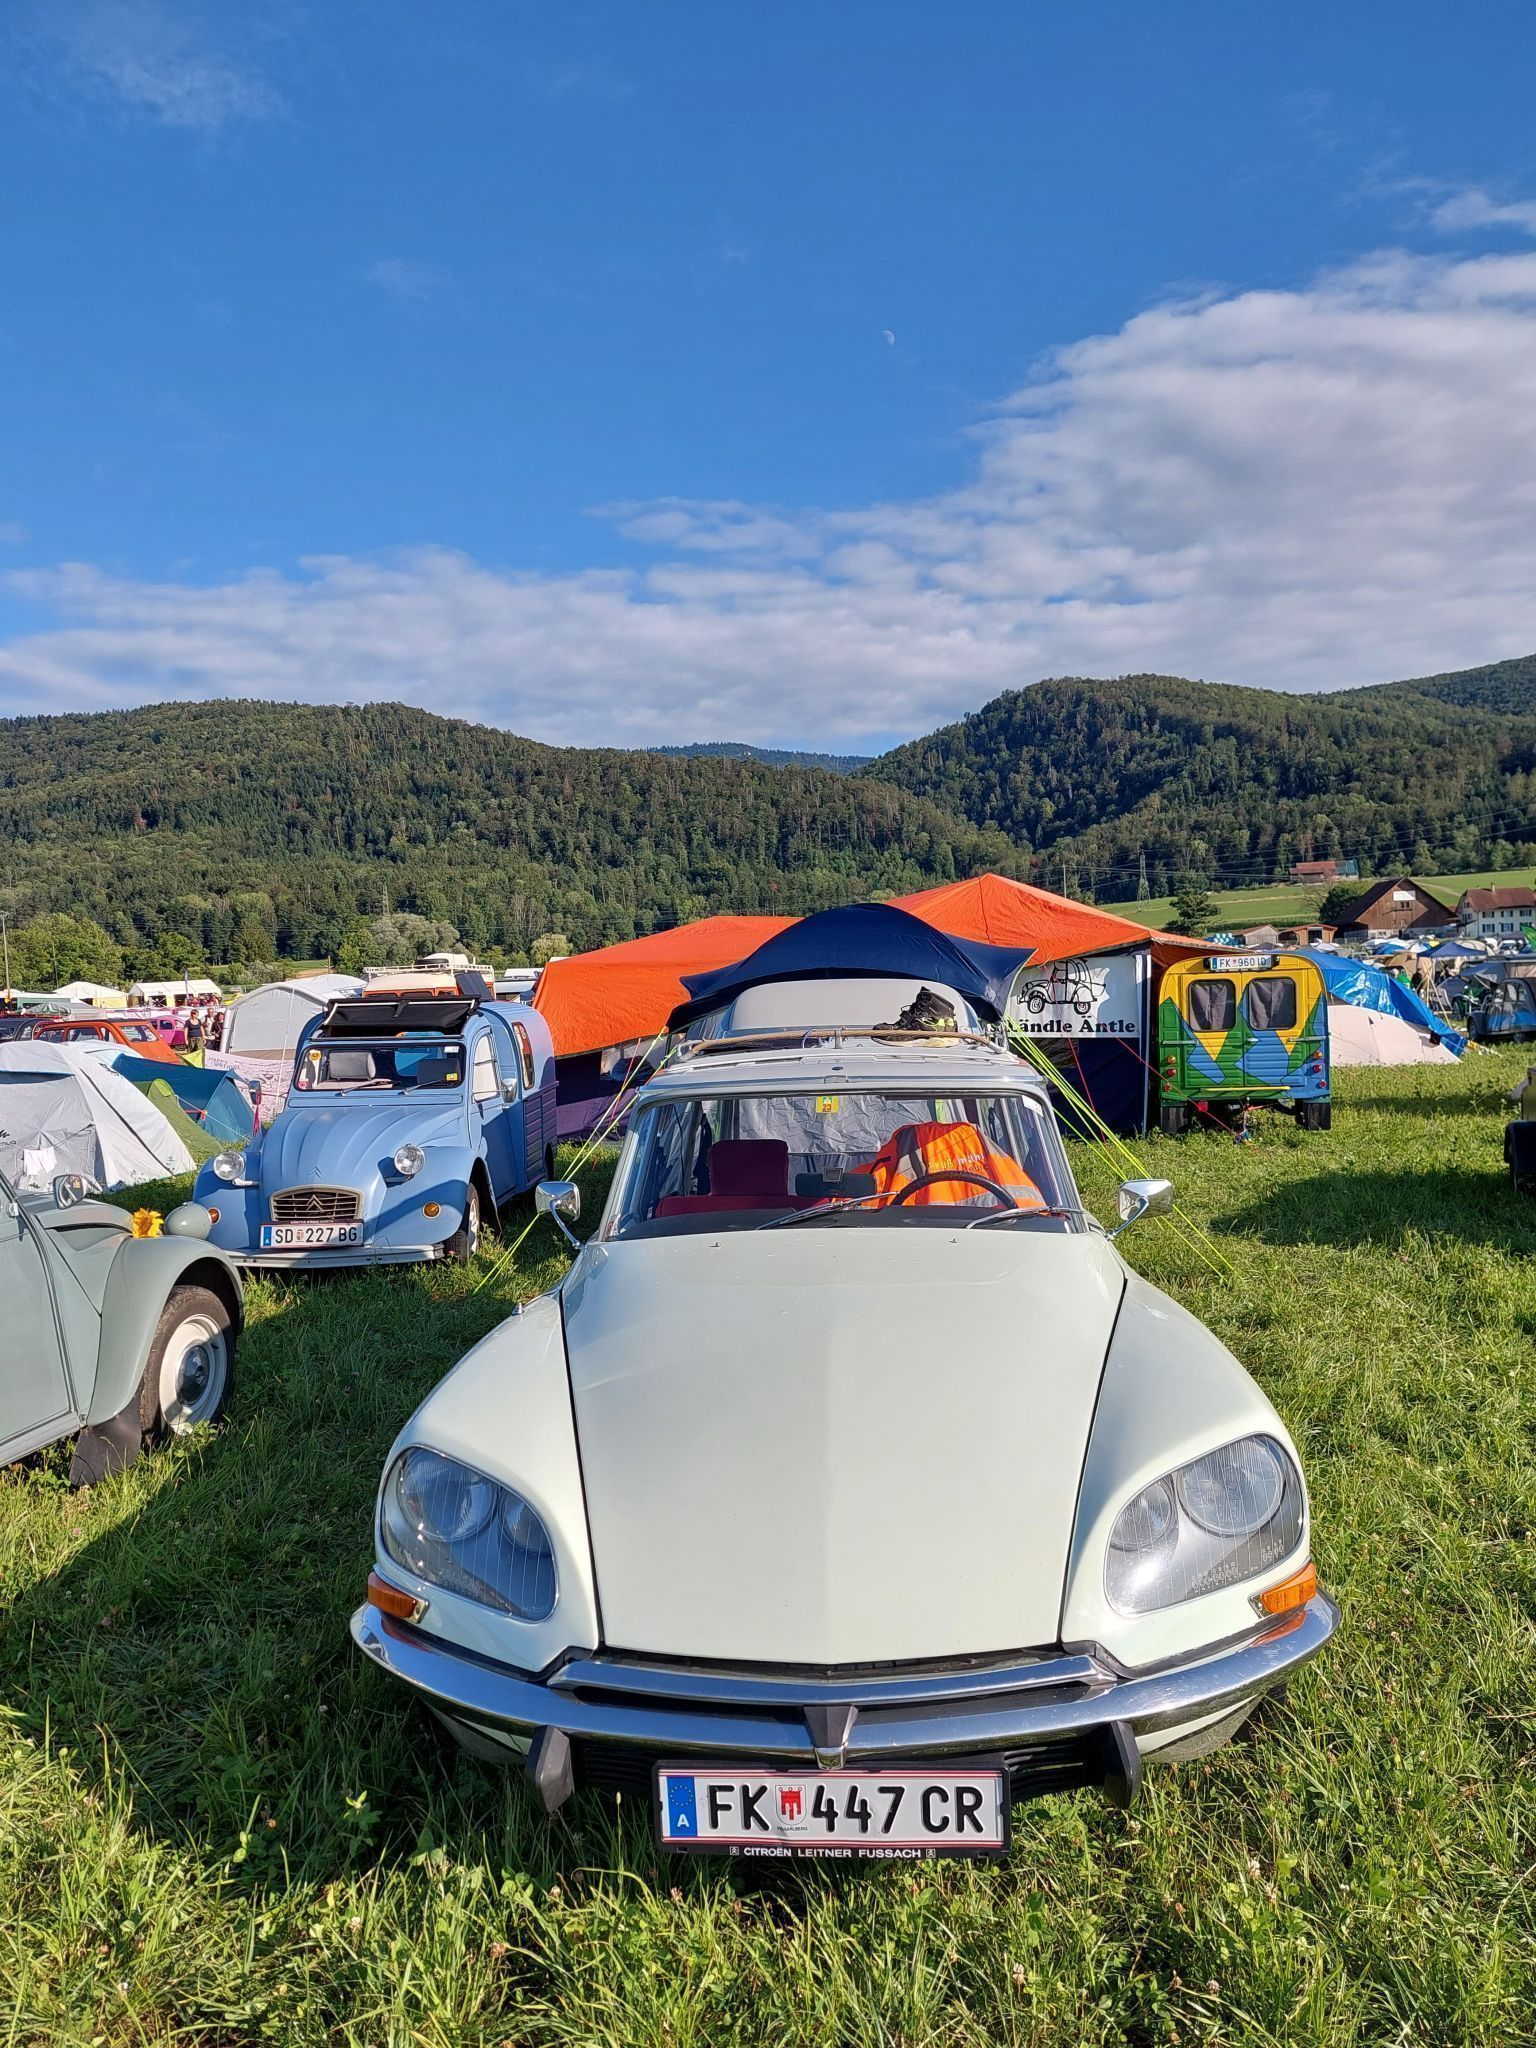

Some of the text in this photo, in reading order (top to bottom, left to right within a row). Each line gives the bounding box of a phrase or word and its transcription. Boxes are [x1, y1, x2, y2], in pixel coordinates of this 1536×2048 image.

[1219, 958, 1231, 967] FK
[1238, 957, 1255, 967] 960
[1079, 1015, 1136, 1033] Äntle
[822, 1103, 832, 1112] 23
[275, 1227, 357, 1243] SD 227 BG
[707, 1784, 985, 1834] FK 447 CR
[676, 1815, 690, 1828] A
[743, 1845, 922, 1859] CITROËN LEITNER FUSSACH
